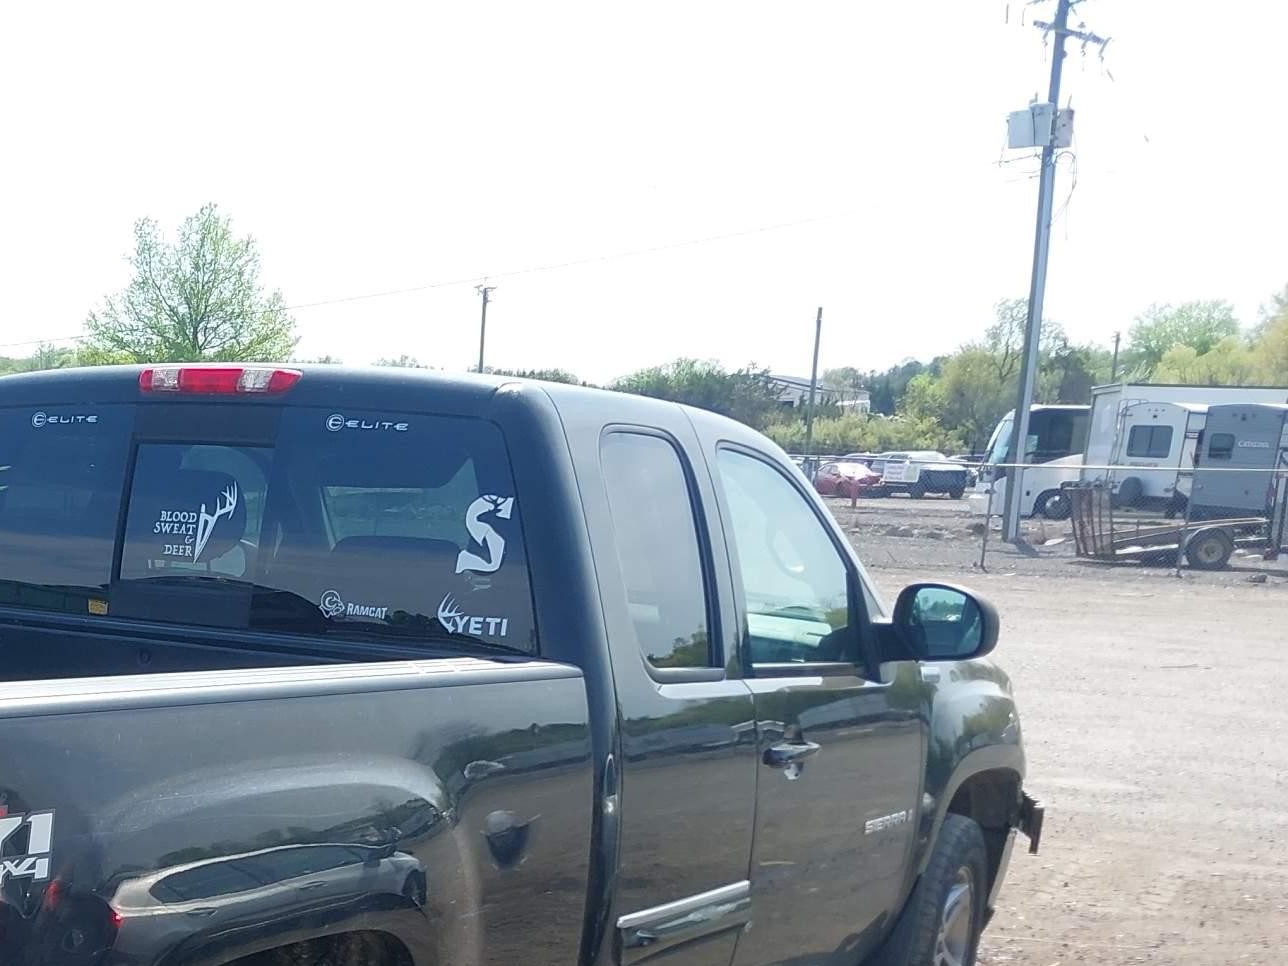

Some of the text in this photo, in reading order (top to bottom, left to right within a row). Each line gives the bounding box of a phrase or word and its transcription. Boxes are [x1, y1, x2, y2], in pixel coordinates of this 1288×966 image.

[47, 415, 98, 424] ELITE
[345, 419, 409, 431] ELITE
[160, 510, 197, 523] BLOOD
[153, 522, 196, 535] SWEAT
[163, 544, 192, 557] DEER
[346, 602, 388, 619] RAMCAT
[455, 615, 509, 637] YETI
